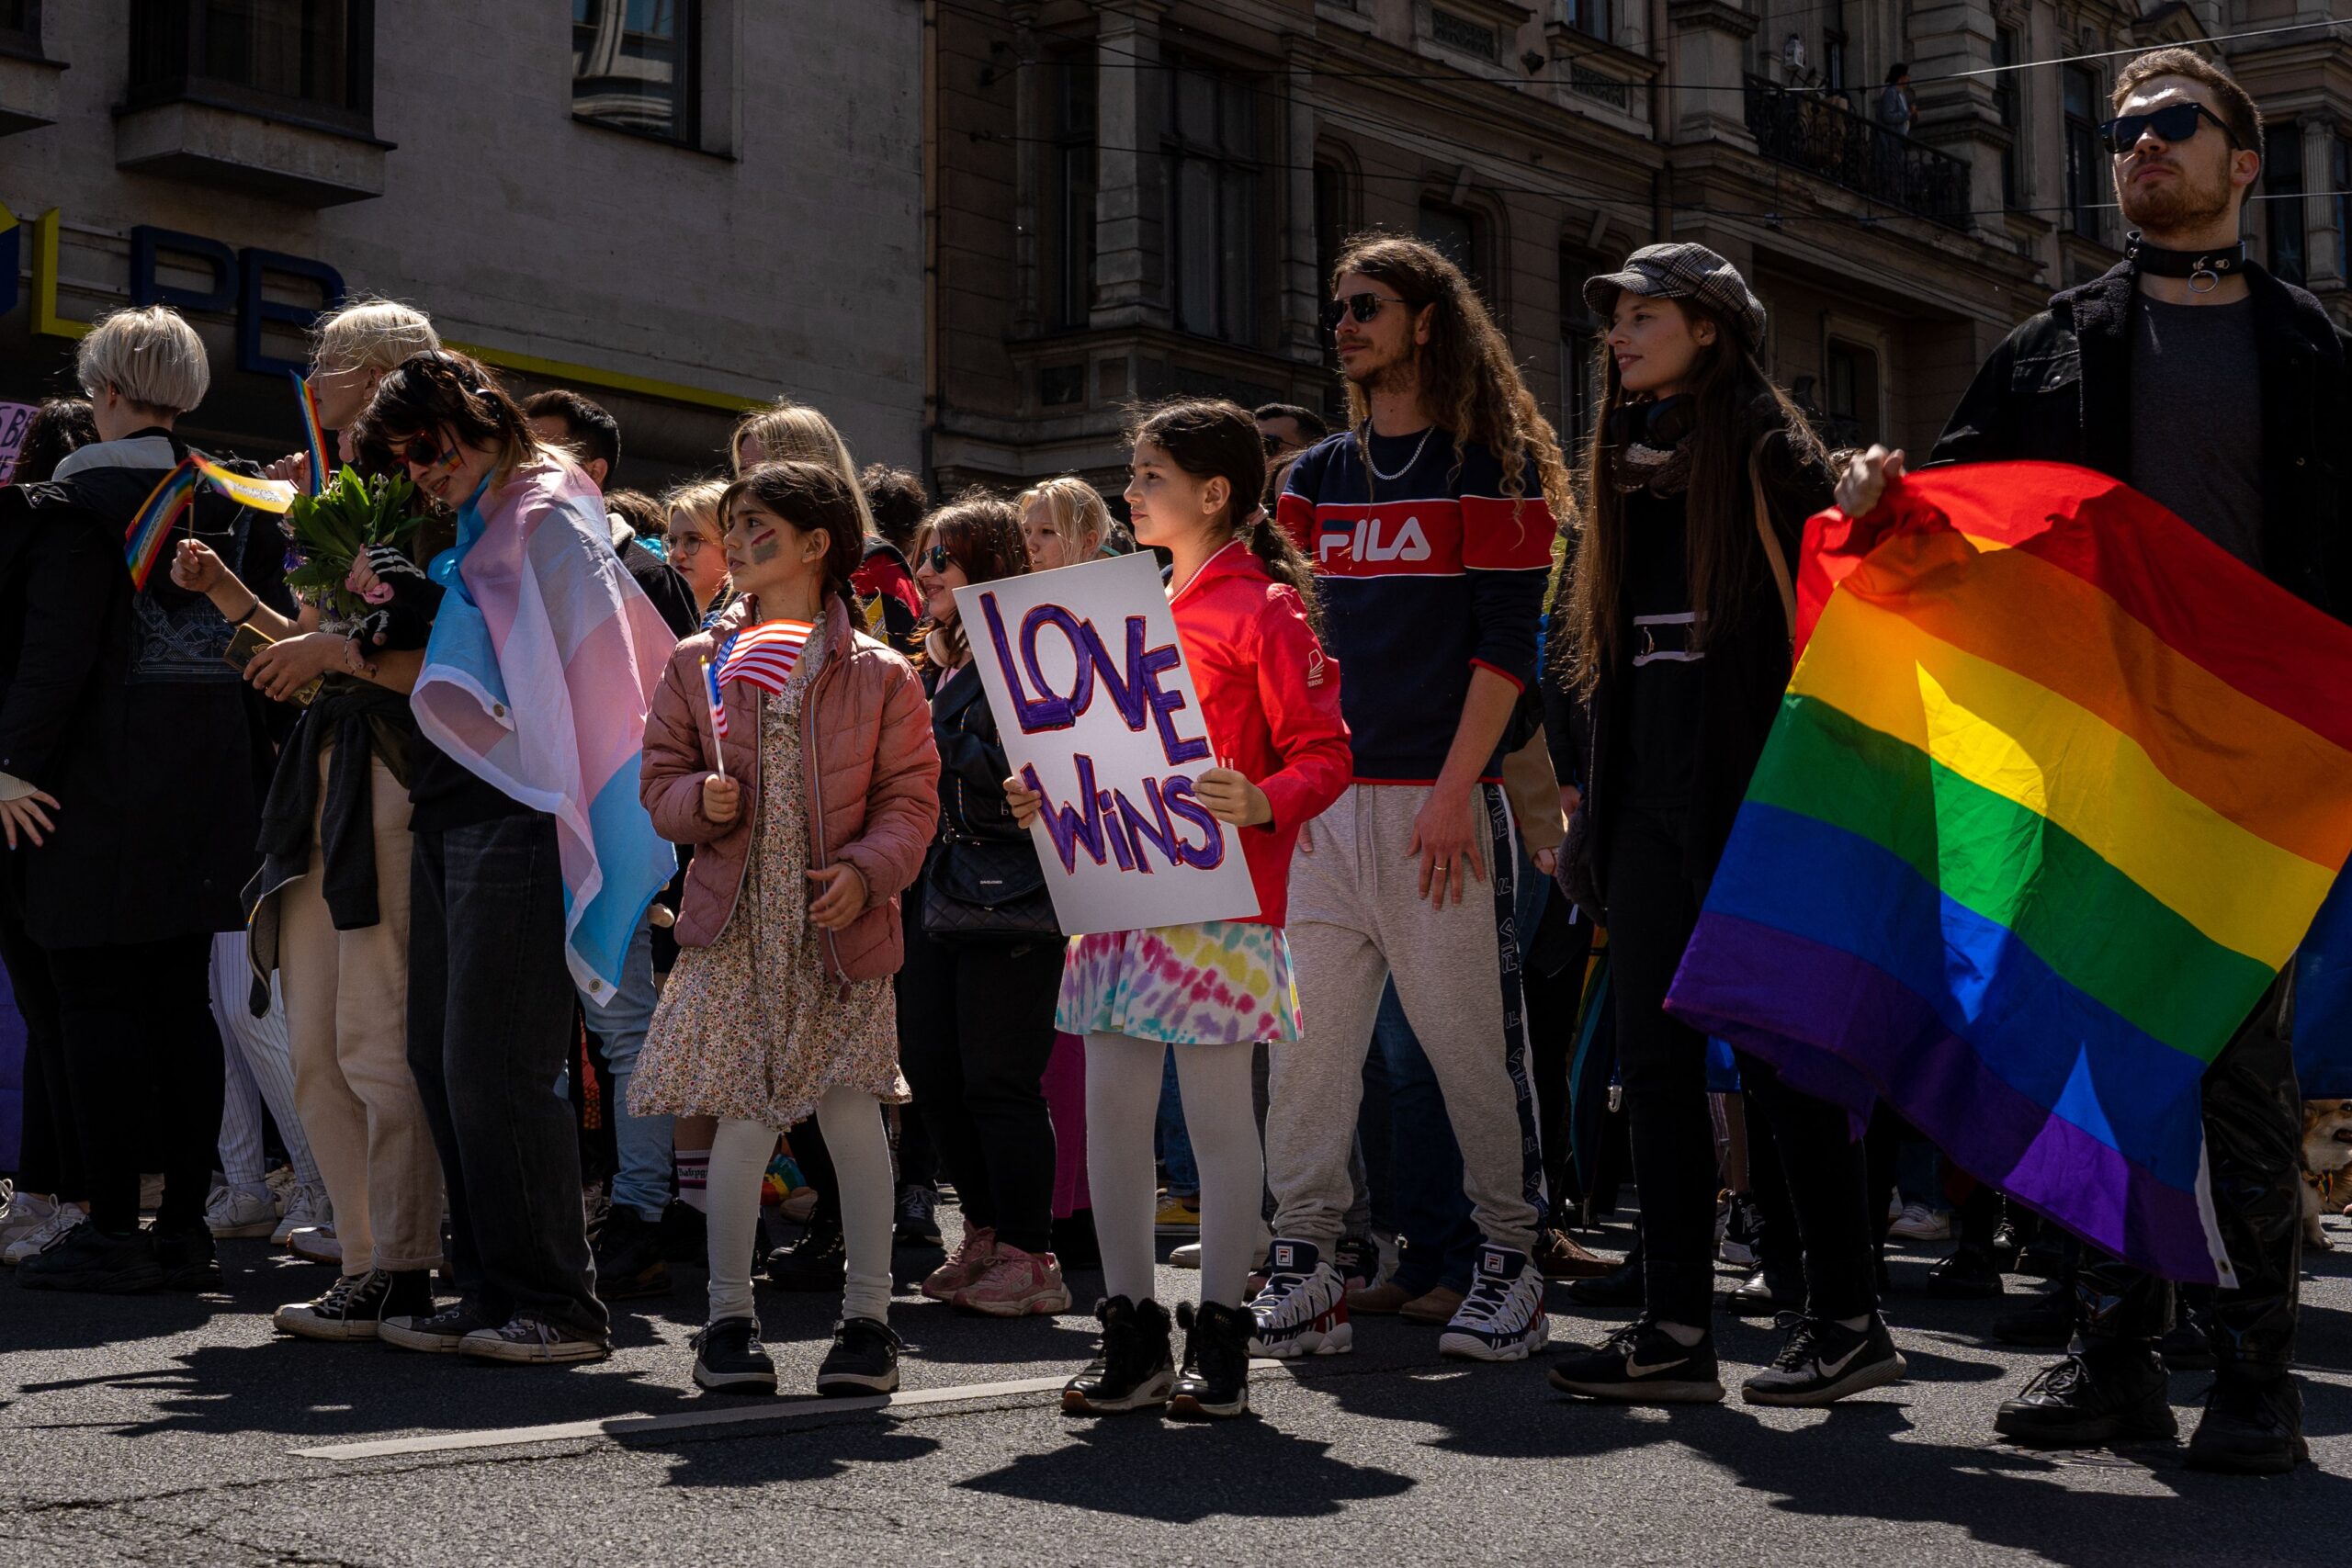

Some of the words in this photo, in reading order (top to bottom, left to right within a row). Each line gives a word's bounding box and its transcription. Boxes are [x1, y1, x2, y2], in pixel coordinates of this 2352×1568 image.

[1319, 516, 1431, 563] FILA
[979, 591, 1212, 766] LOVE
[1487, 785, 1509, 840] FILA
[1499, 917, 1518, 975] FILA
[1508, 1046, 1532, 1102] FILA
